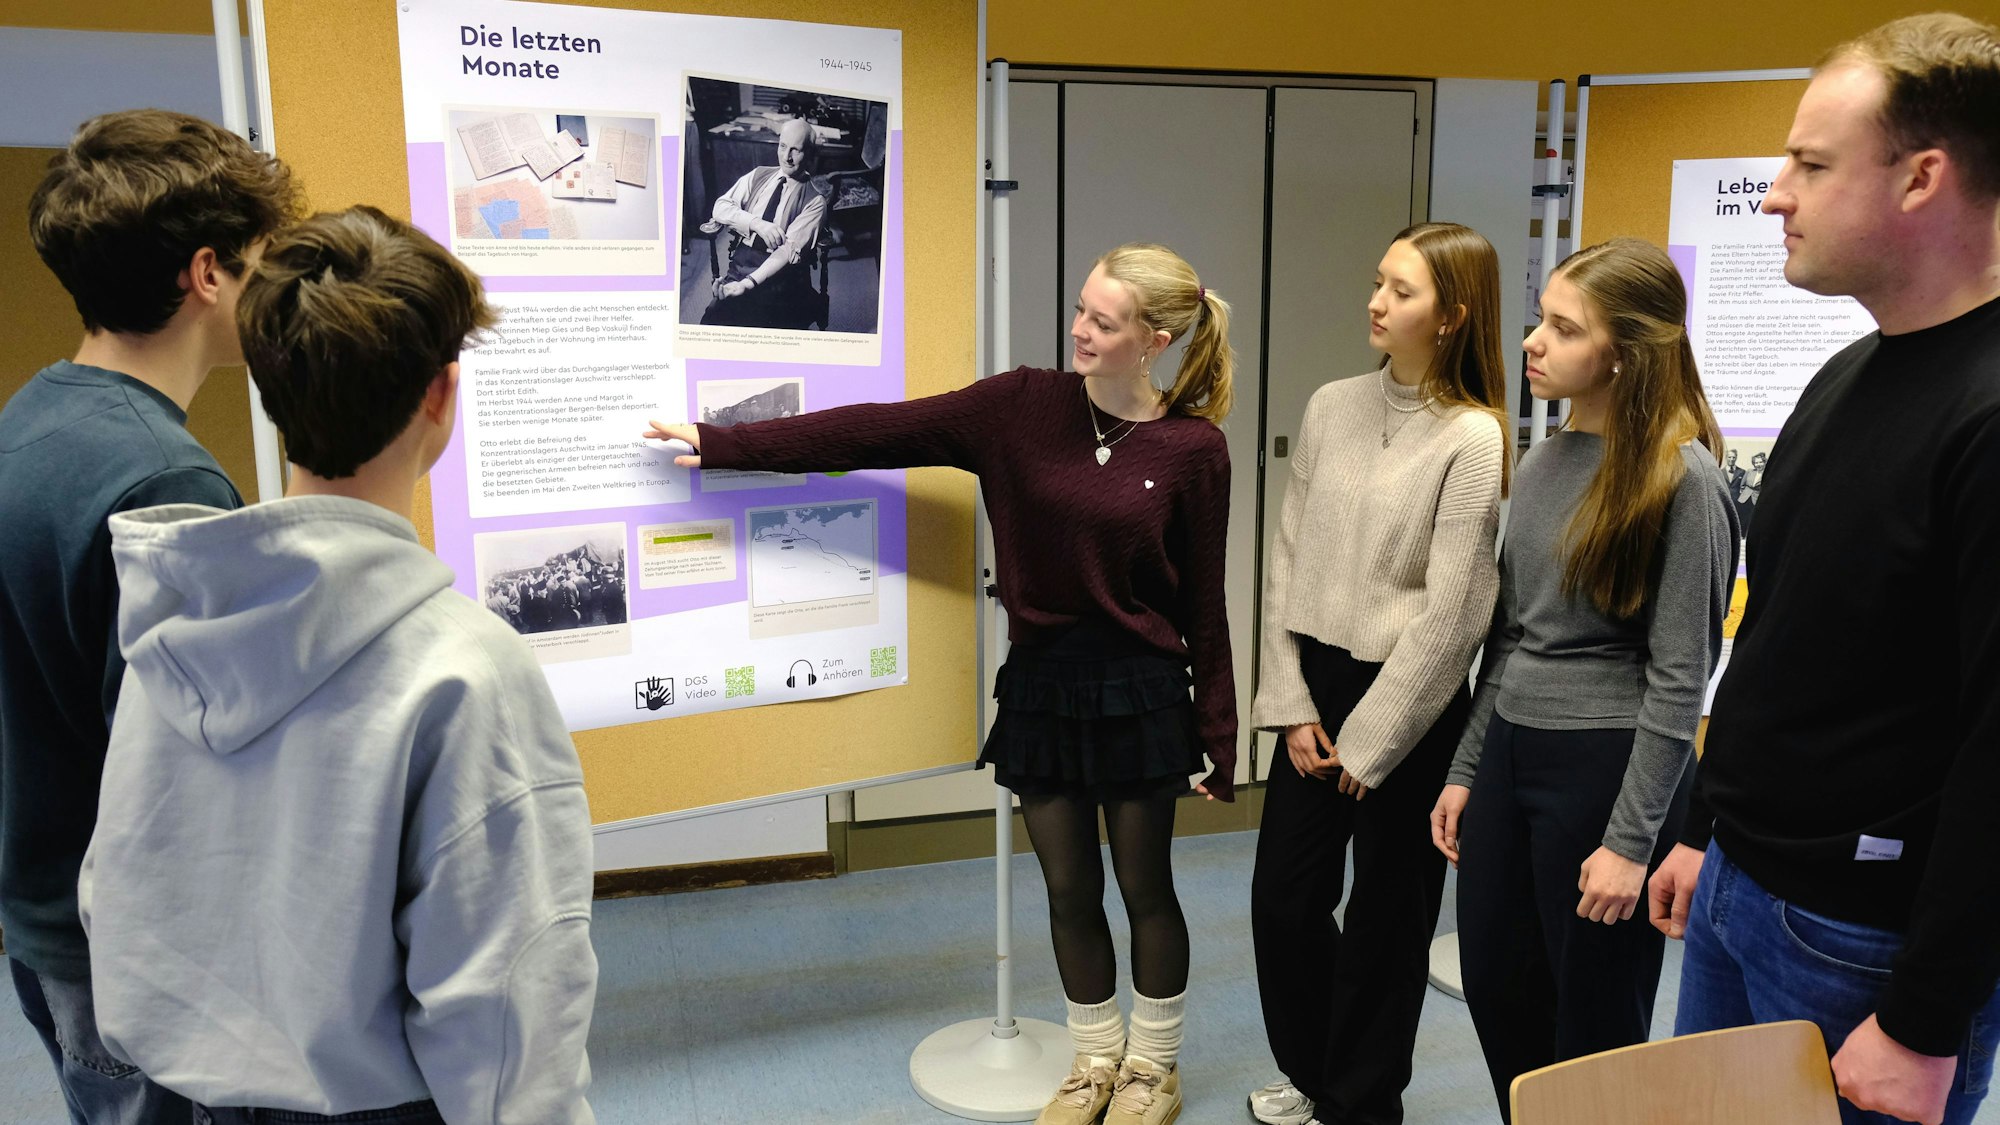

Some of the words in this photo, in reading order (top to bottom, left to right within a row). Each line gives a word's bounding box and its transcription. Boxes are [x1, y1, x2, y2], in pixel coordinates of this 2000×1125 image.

[460, 24, 503, 48] Die
[512, 26, 602, 54] letzten
[462, 54, 560, 79] Monate
[1716, 199, 1740, 216] im
[1748, 200, 1762, 214] V
[540, 305, 567, 313] werden
[600, 304, 635, 312] Menschen
[558, 315, 572, 323] und
[611, 314, 633, 322] Helfer.
[1817, 313, 1850, 321] rausgehen
[532, 326, 550, 335] Miep
[552, 325, 568, 333] Gies
[586, 325, 600, 334] Bep
[602, 324, 628, 334] Voskuijl
[498, 336, 535, 346] Tagebuch
[560, 335, 595, 345] Wohnung
[607, 334, 646, 342] Hinterhaus.
[474, 348, 492, 357] Miep
[494, 347, 525, 355] bewahrt
[538, 346, 551, 354] auf.
[1747, 353, 1779, 361] Tagebuch.
[475, 368, 500, 376] Familie
[502, 367, 521, 375] Frank
[541, 366, 556, 374] über
[572, 364, 629, 374] Durchgangslager
[631, 362, 669, 371] Westerbork
[485, 378, 498, 386] das
[500, 375, 573, 387] Konzentrationslager
[575, 374, 611, 382] Auschwitz
[613, 372, 655, 383] verschleppt.
[496, 388, 515, 396] stirbt
[518, 387, 538, 395] Edith.
[477, 399, 486, 407] Im
[489, 398, 514, 406] Herbst
[516, 397, 532, 405] 1944
[534, 396, 562, 404] werden
[564, 395, 582, 403] Anne
[584, 394, 597, 402] und
[600, 393, 624, 403] Margot
[478, 409, 491, 417] das
[493, 406, 566, 418] Konzentrationslager
[568, 403, 619, 414] Bergen-Belsen
[621, 401, 658, 412] deportiert.
[492, 418, 520, 426] sterben
[522, 417, 549, 427] wenige
[552, 415, 578, 423] Monate
[580, 414, 604, 424] später.
[480, 439, 497, 447] Otto
[499, 438, 521, 446] erlebt
[524, 437, 535, 445] die
[537, 435, 571, 446] Befreiung
[574, 434, 586, 442] des
[481, 446, 557, 459] Konzentrationslagers
[560, 444, 595, 453] Auschwitz
[608, 442, 629, 450] Januar
[632, 440, 650, 448] 1945.
[491, 458, 523, 467] überlebt
[525, 457, 535, 465] als
[537, 455, 565, 466] einziger
[567, 454, 579, 462] der
[581, 450, 642, 463] Untergetauchten.
[496, 466, 546, 478] gegnerischen
[548, 464, 576, 473] Armeen
[578, 462, 607, 471] befreien
[609, 461, 625, 469] nach
[627, 460, 640, 468] und
[643, 459, 659, 467] nach
[497, 477, 533, 487] besetzten
[535, 475, 566, 484] Gebiete.
[497, 487, 529, 497] beenden
[532, 486, 540, 494] im
[543, 485, 554, 493] Mai
[557, 484, 570, 492] den
[572, 482, 600, 491] Zweiten
[602, 480, 636, 491] Weltkrieg
[638, 479, 644, 487] in
[646, 477, 673, 488] Europa.
[822, 658, 844, 668] Zum
[823, 668, 863, 680] Anhören
[685, 676, 708, 686] DGS
[685, 689, 716, 699] Video
